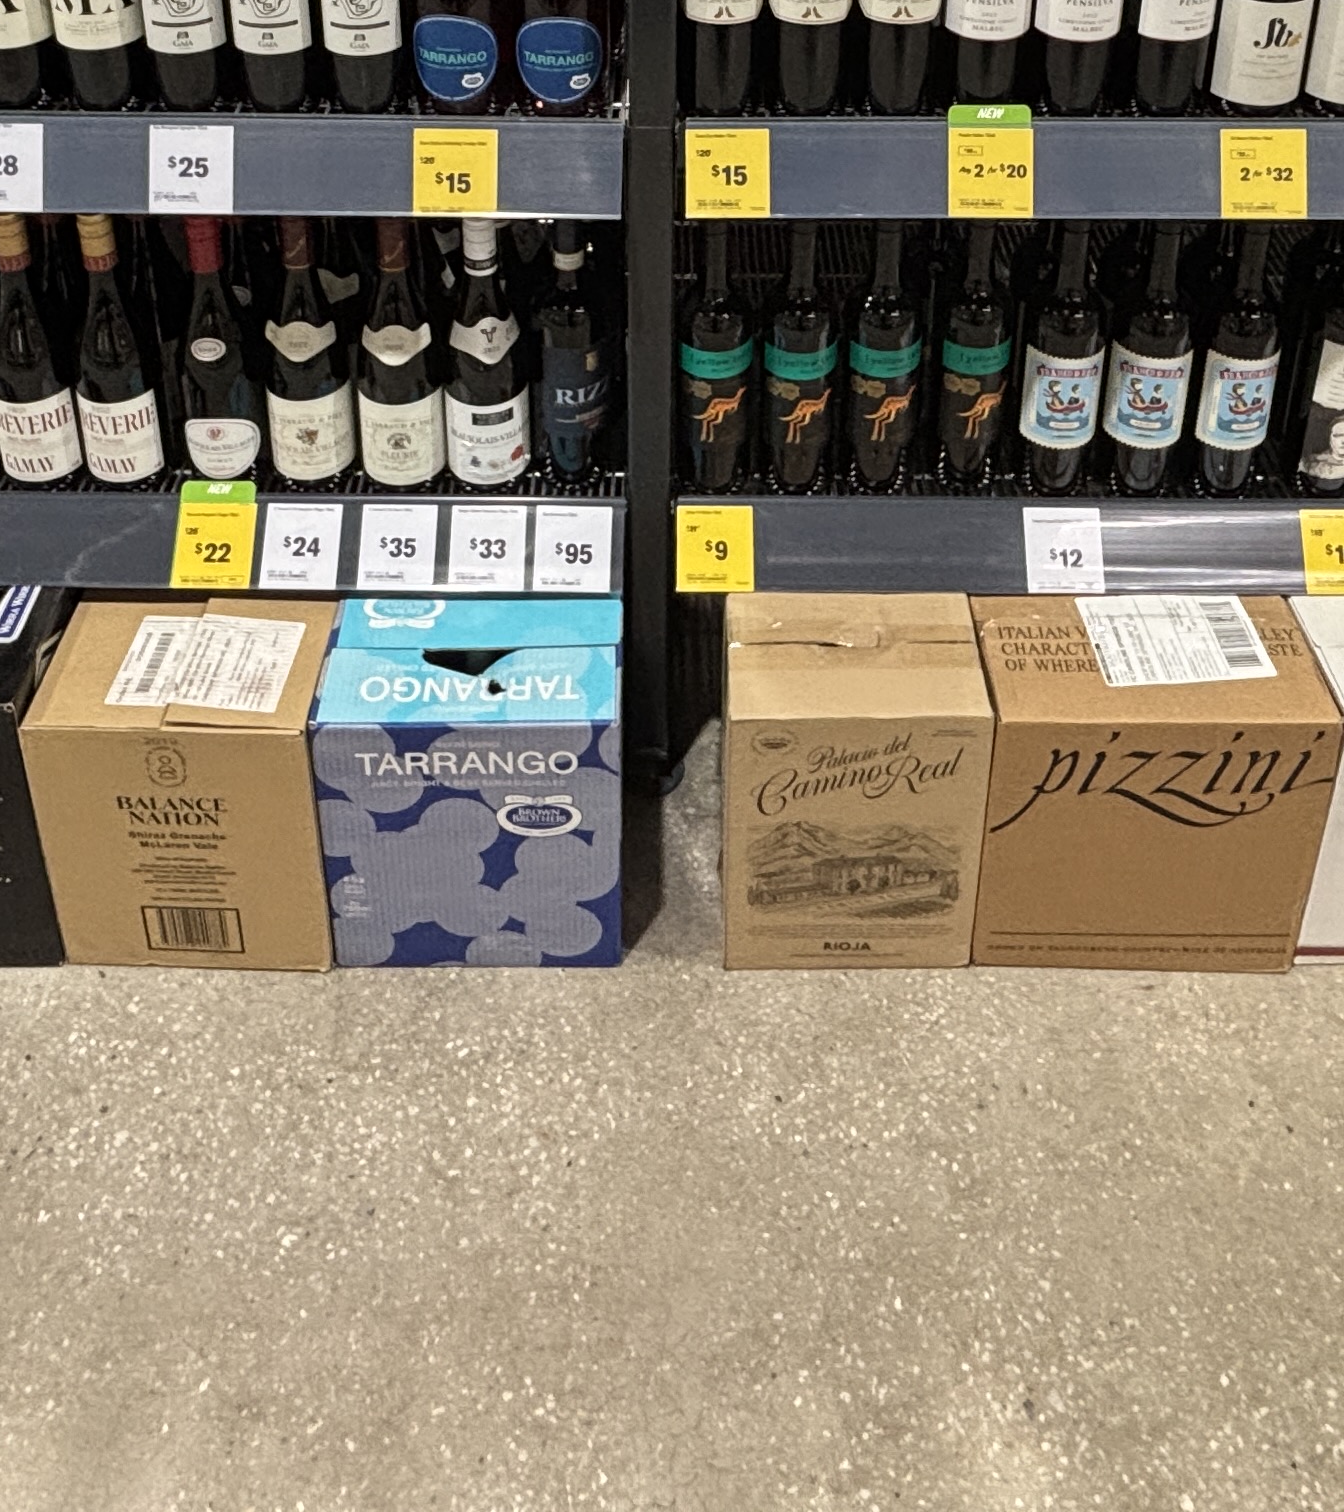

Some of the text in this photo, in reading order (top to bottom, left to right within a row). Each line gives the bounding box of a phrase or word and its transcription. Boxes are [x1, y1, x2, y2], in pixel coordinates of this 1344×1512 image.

[418, 48, 488, 66] TARRANGO
[523, 49, 594, 67] TARRANGO
[976, 106, 1005, 120] NEW
[167, 155, 209, 178] $25
[711, 164, 748, 187] $15
[973, 163, 985, 179] 2
[999, 163, 1029, 180] $20
[1239, 167, 1251, 182] 2
[1265, 165, 1294, 182] $32
[434, 171, 472, 194] $15
[82, 403, 156, 434] REVERIE
[4, 453, 55, 474] GAMAY
[87, 453, 138, 474] GAMAY
[206, 481, 234, 496] NEW
[193, 540, 233, 565] $22
[282, 534, 322, 559] $24
[378, 535, 418, 560] $35
[468, 536, 508, 561] $33
[554, 542, 594, 566] $95
[704, 538, 729, 562] $9
[1048, 547, 1084, 569] $12
[996, 625, 1072, 640] ITALIAN
[1005, 658, 1099, 674] OF WHERE
[359, 674, 581, 704] TARRANGO
[806, 733, 912, 772] Palacio del
[355, 750, 579, 777] TARRANGO
[756, 748, 963, 817] Camino Real
[989, 731, 1336, 833] pizzini
[115, 795, 227, 813] BALANCE
[517, 807, 561, 819] BROWN
[128, 810, 222, 827] NATION
[139, 840, 219, 851] McLaren Vale
[168, 831, 227, 841] Grenache
[822, 940, 872, 953] RIOJA
